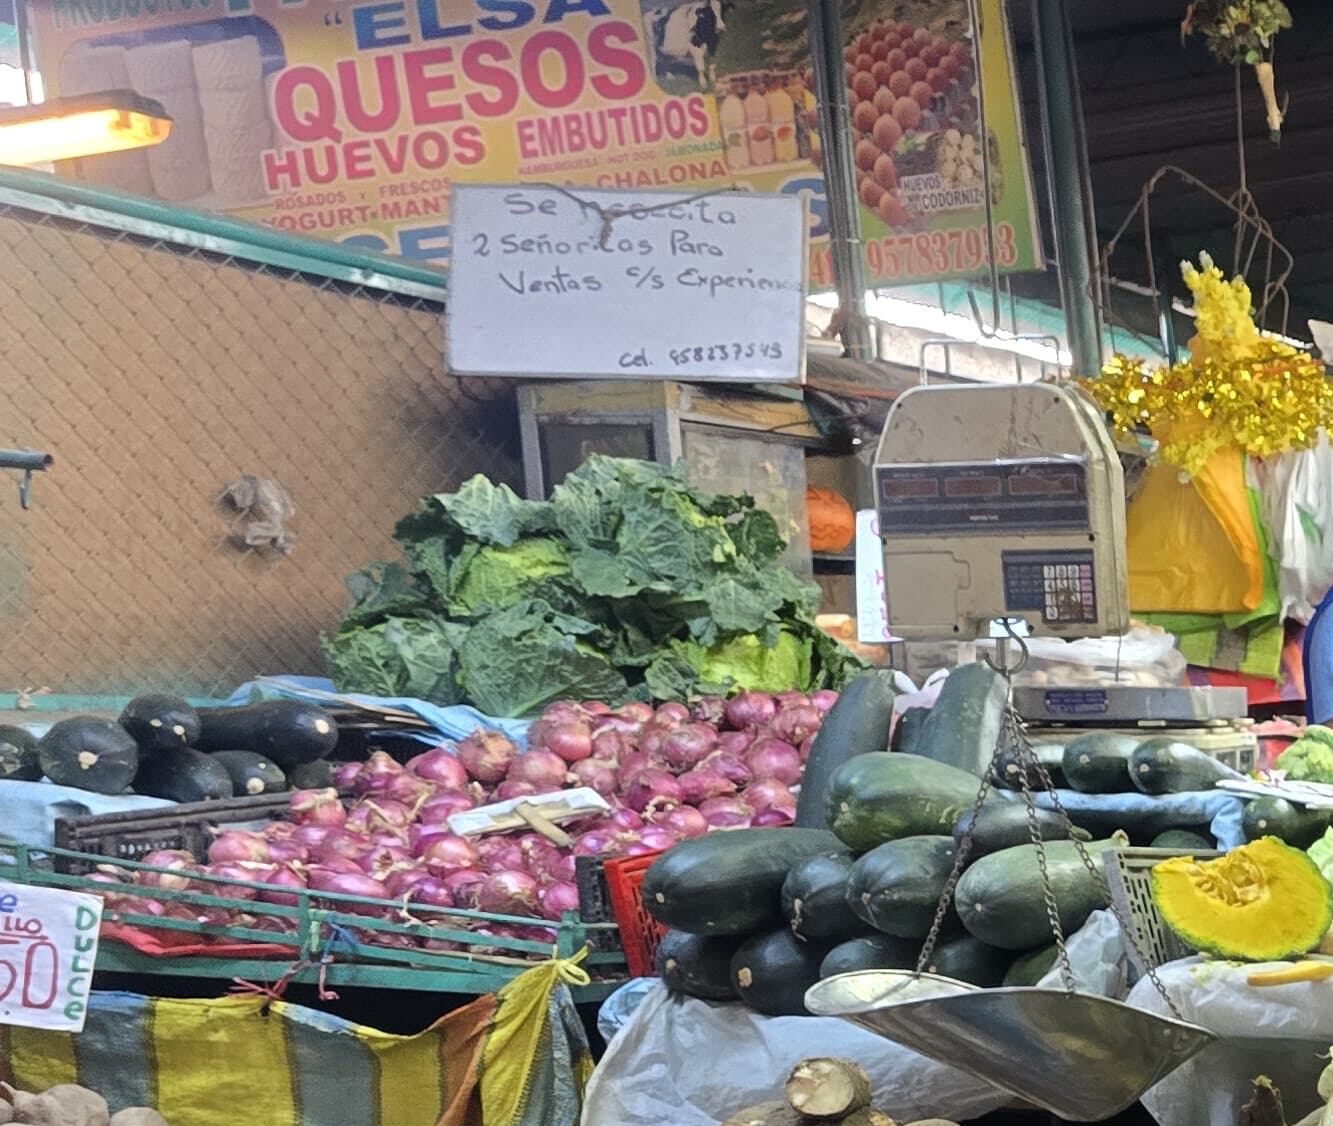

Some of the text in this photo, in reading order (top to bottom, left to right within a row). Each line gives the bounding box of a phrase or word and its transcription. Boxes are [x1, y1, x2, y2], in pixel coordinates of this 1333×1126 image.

[274, 21, 646, 143] QUESOS
[263, 97, 709, 192] HUEVOS EMBUTIDOS
[597, 159, 727, 189] CHALONA
[504, 193, 557, 217] Se
[472, 232, 489, 257] 2
[669, 229, 724, 257] Para
[499, 266, 603, 296] Ventas
